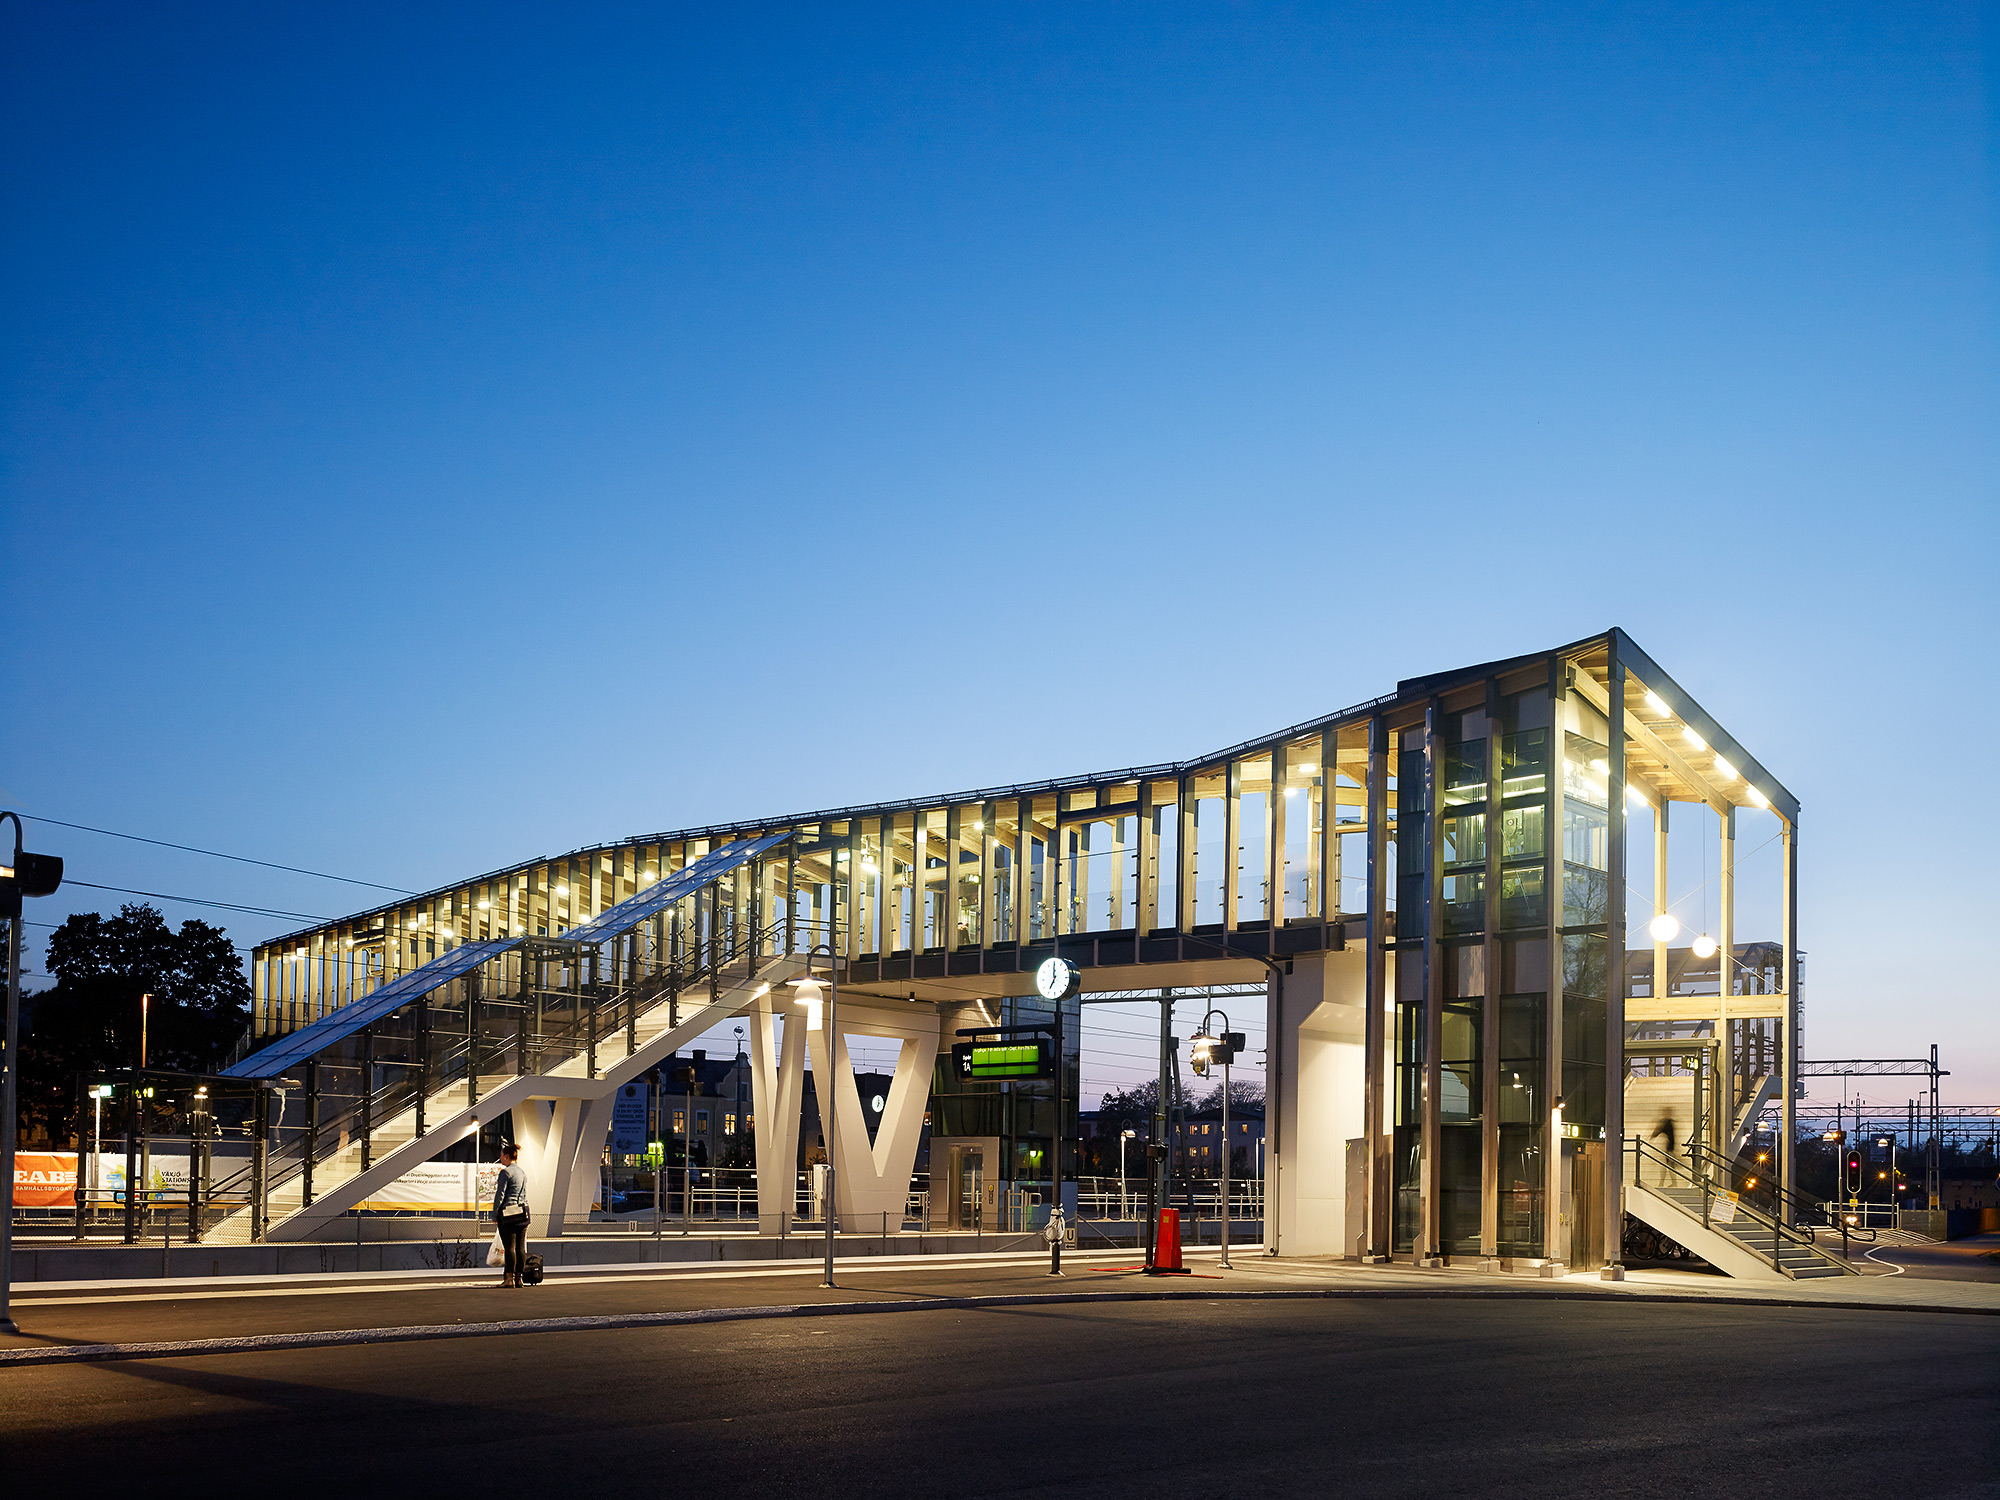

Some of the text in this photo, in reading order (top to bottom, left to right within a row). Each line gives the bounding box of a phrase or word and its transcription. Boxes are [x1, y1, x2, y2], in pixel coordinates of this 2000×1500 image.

[962, 1062, 971, 1071] 1A
[13, 1170, 66, 1183] EAB
[1067, 1230, 1074, 1241] U
